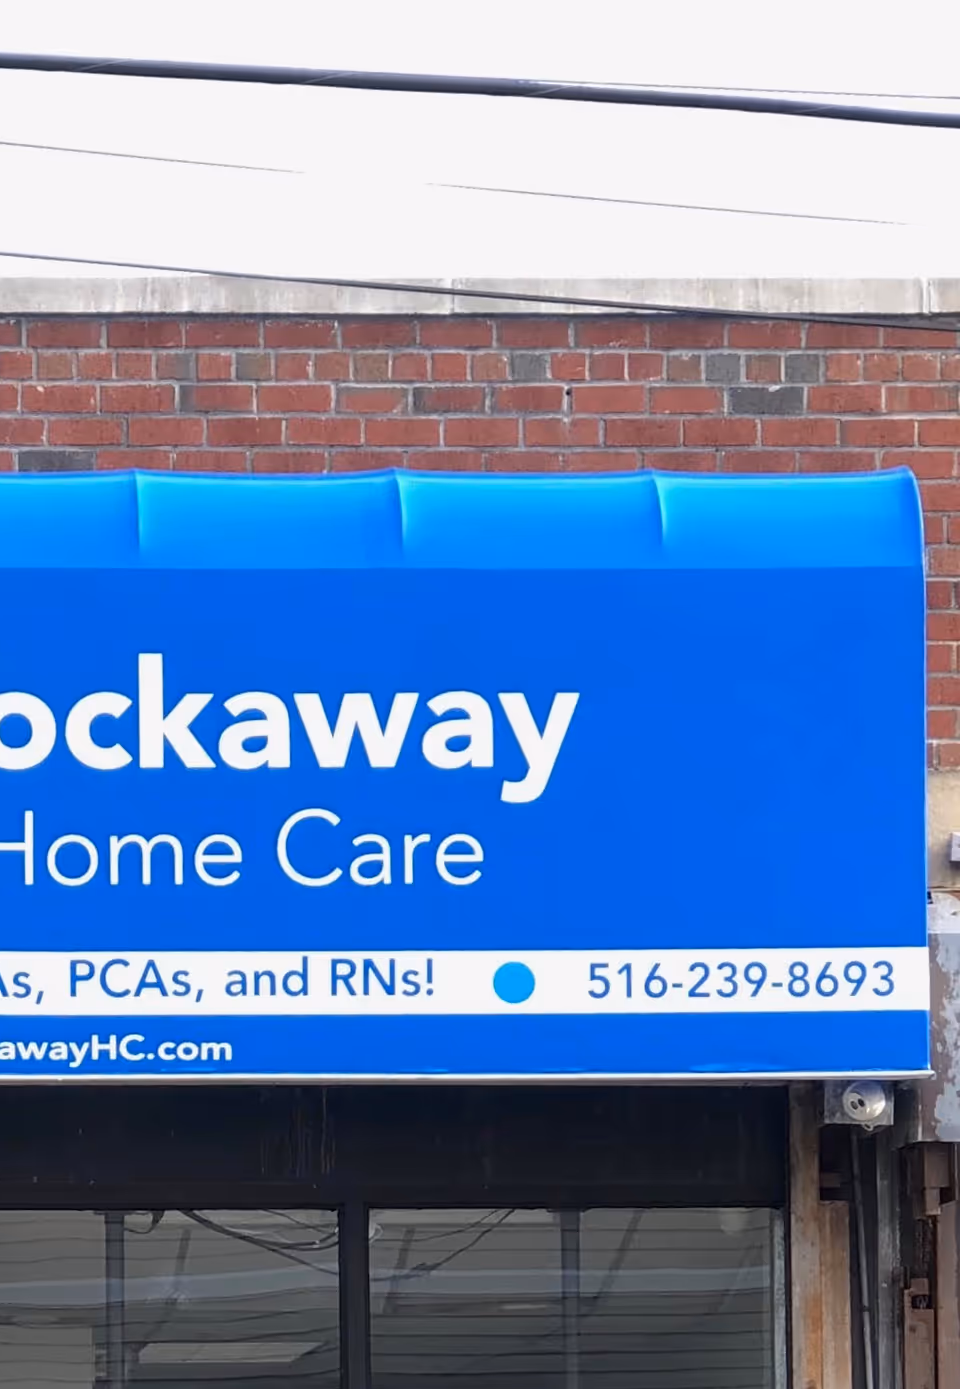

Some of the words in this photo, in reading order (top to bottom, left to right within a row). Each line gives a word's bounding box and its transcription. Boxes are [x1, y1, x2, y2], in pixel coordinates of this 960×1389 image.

[276, 807, 485, 887] Care
[69, 958, 203, 1003] PCAs,
[225, 956, 309, 997] and
[330, 958, 434, 997] RNs!
[588, 960, 894, 999] 516-239-8693
